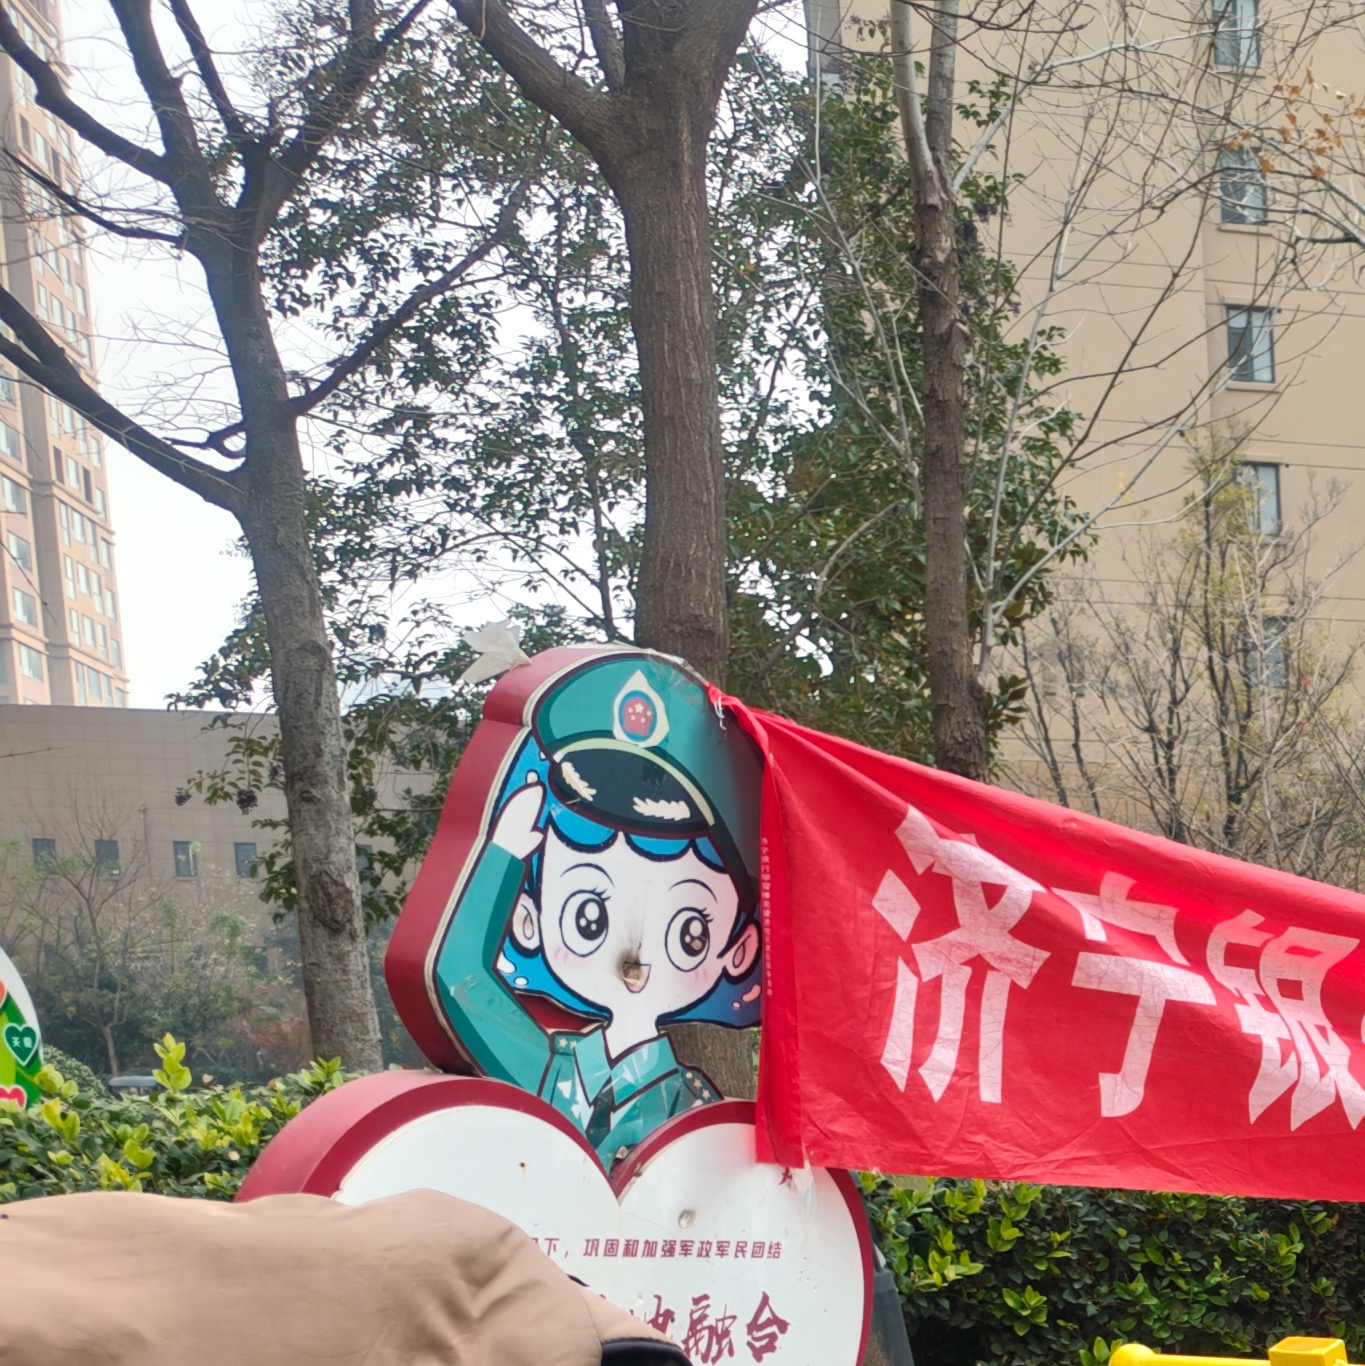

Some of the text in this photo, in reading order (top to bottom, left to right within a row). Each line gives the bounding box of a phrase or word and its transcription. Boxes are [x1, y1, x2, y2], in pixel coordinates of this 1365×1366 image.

[530, 1237, 783, 1260] 下，巩固和加强军政军民团结
